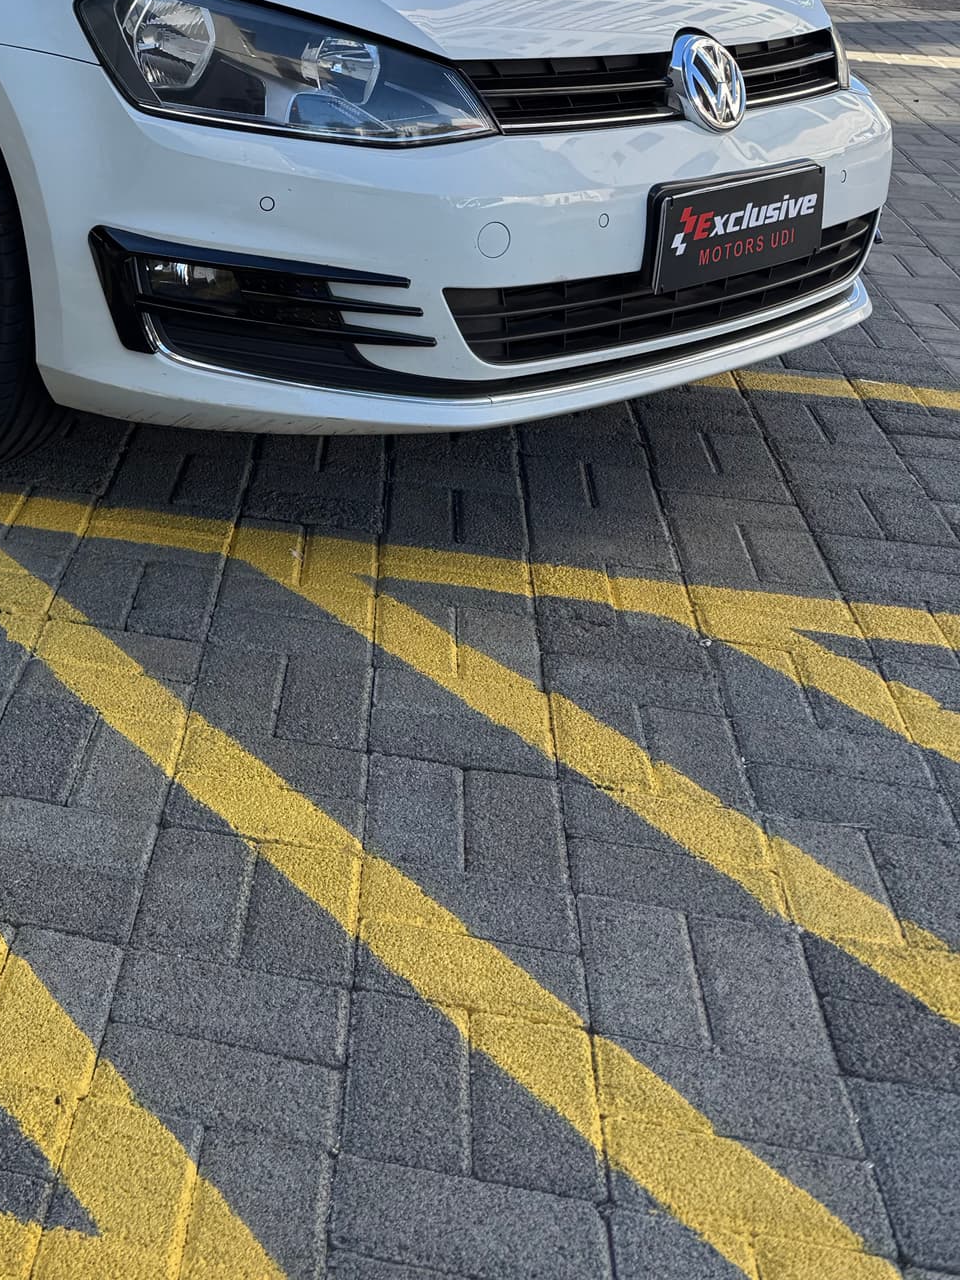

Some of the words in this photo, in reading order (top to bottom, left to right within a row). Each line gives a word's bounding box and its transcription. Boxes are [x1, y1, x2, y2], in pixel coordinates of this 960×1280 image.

[693, 193, 818, 241] Exclusive
[698, 235, 764, 266] MOTORS
[770, 227, 796, 249] UDI
